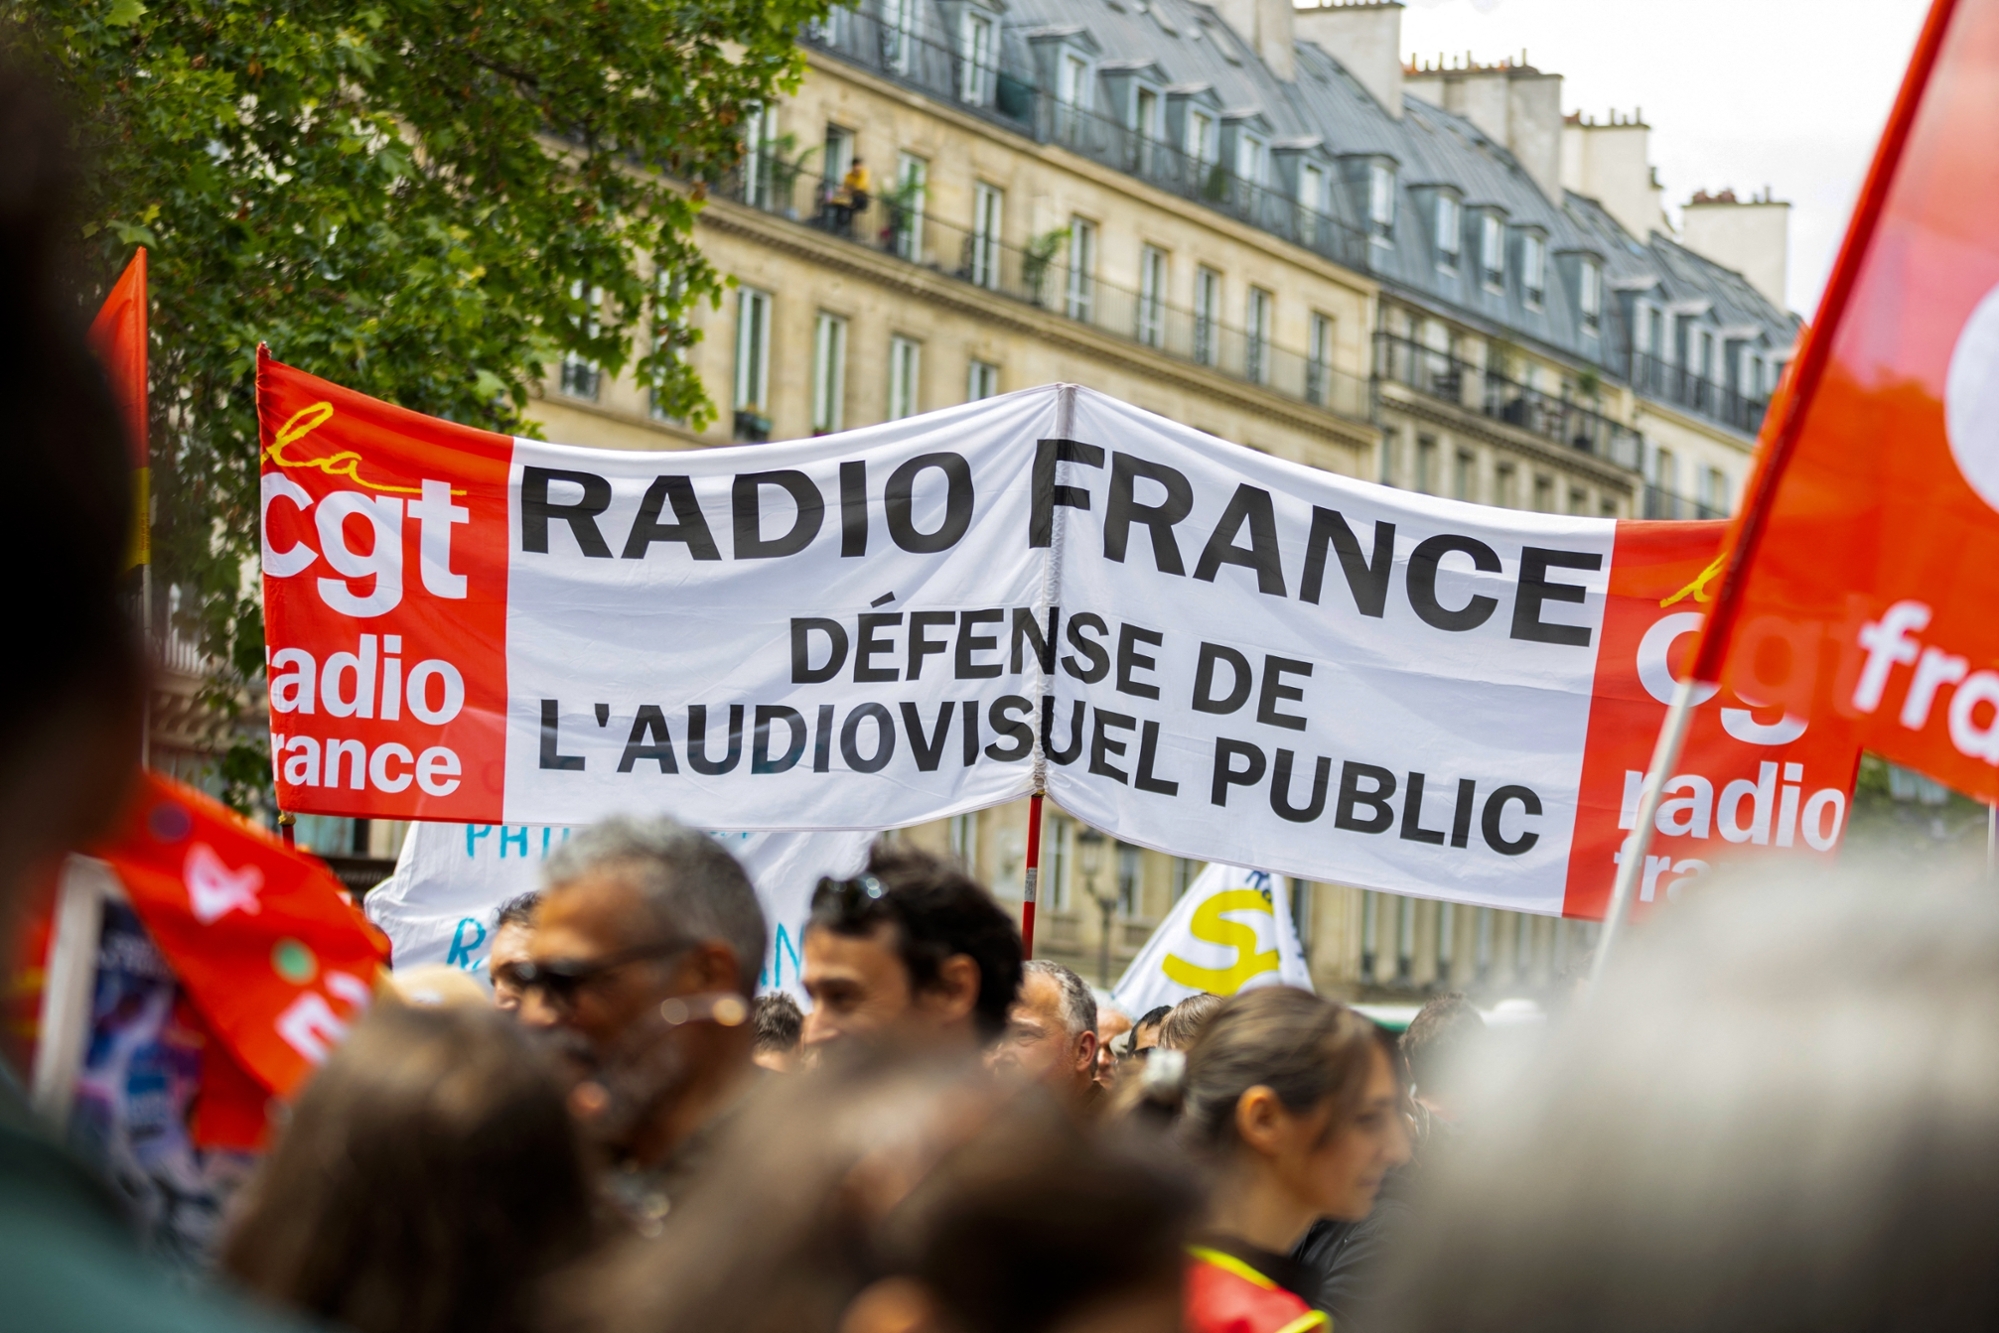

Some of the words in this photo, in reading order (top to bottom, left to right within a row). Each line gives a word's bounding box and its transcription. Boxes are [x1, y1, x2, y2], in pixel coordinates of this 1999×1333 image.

[261, 401, 467, 496] la
[261, 472, 470, 618] cgt
[521, 452, 975, 561] RADIO
[1029, 439, 1602, 647] FRANCE
[265, 633, 466, 726] adio
[791, 591, 1164, 700] DÉFENSE
[1192, 641, 1314, 731] DE
[269, 716, 462, 797] rance
[539, 695, 1179, 796] L'AUDIOVISUEL
[1210, 737, 1543, 855] PUBLIC
[1618, 760, 1846, 852] radio
